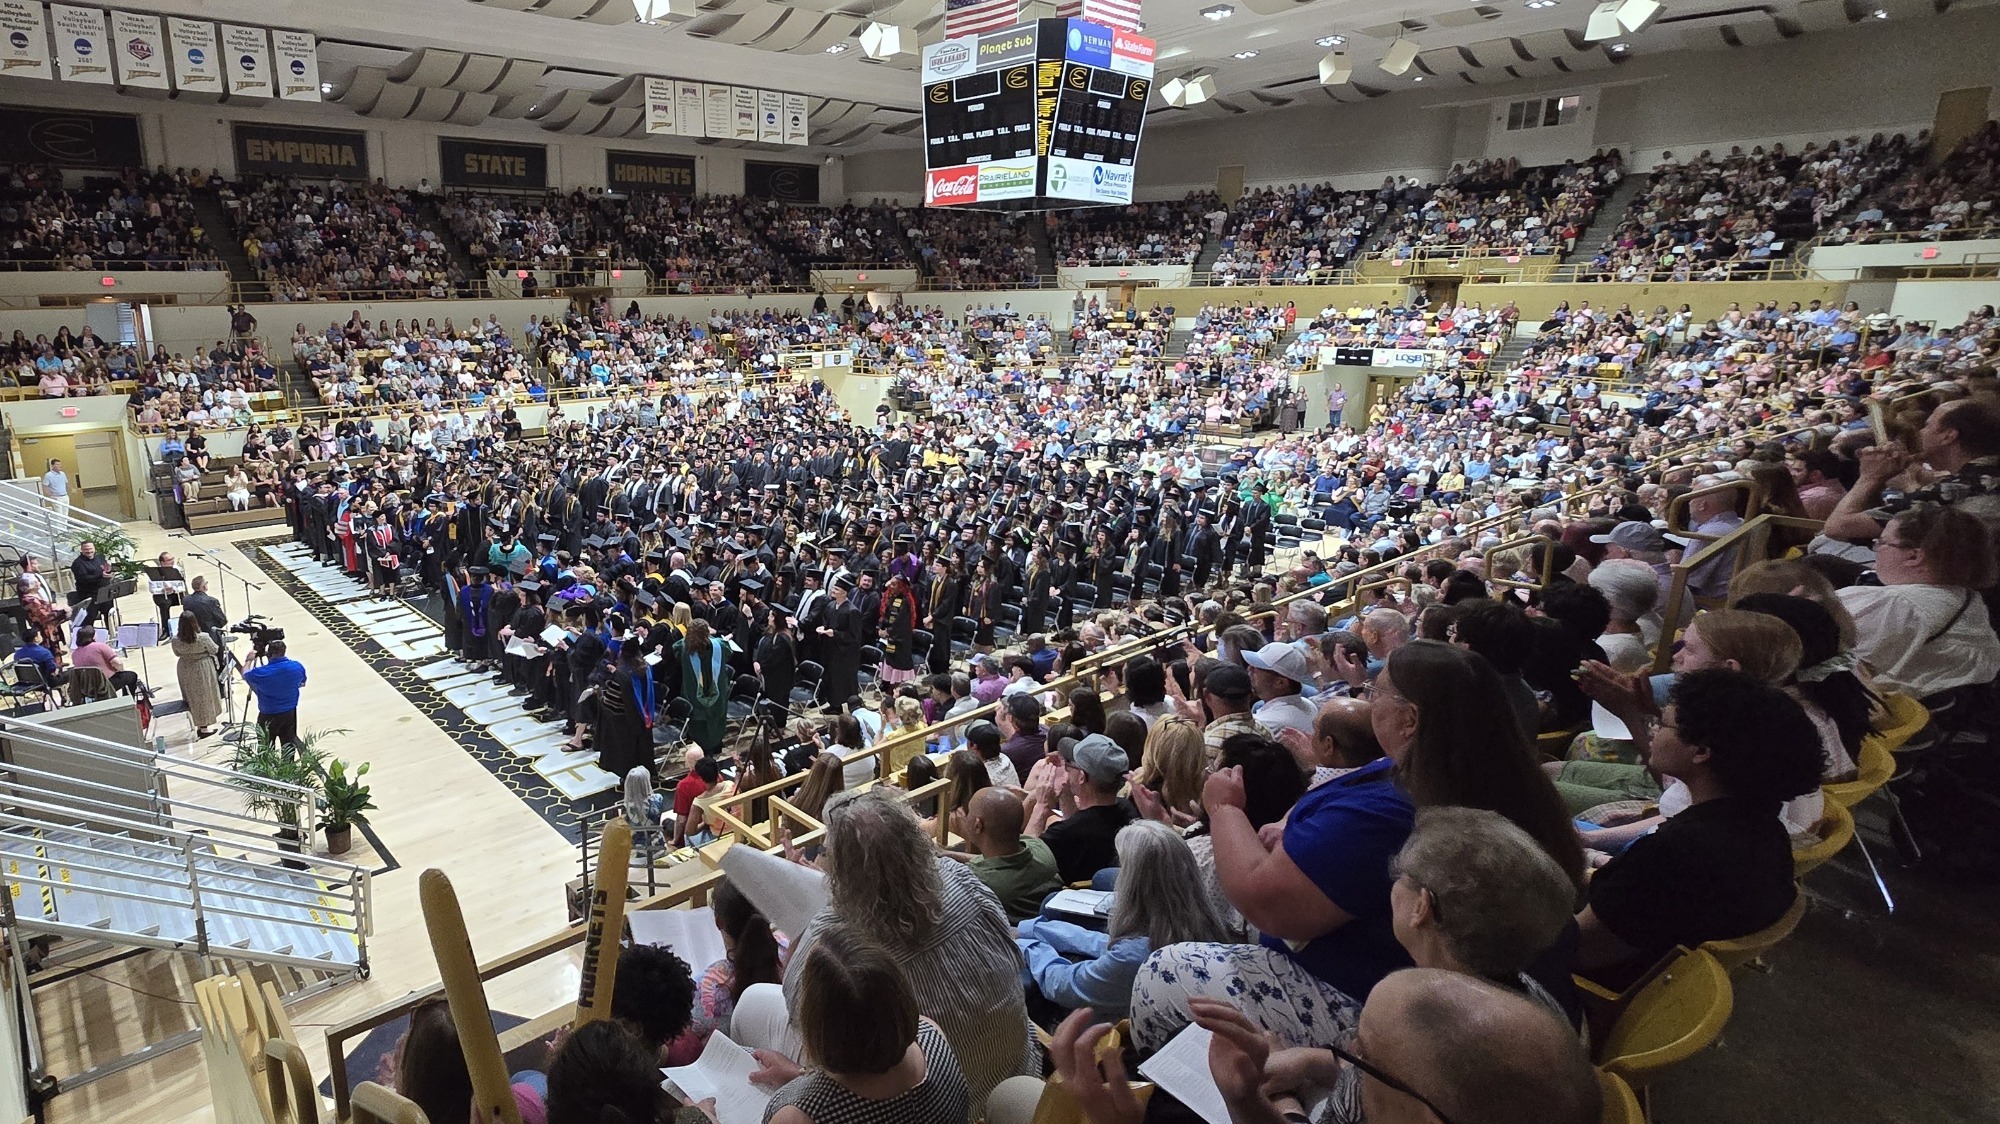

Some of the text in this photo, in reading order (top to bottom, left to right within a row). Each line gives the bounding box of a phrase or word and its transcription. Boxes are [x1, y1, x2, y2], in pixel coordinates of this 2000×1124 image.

[63, 15, 97, 24] Volleyball
[120, 21, 154, 29] Volleyball
[3, 23, 32, 31] Regional
[66, 28, 97, 36] Regional
[119, 27, 156, 35] Champions
[231, 34, 259, 42] Volleyball
[980, 35, 1033, 55] Planet Sub
[1083, 35, 1111, 48] NEWMAN
[932, 52, 966, 66] WILLIAMS
[1038, 61, 1062, 87] William
[1038, 97, 1057, 117] White
[1038, 118, 1053, 156] Auditorium
[247, 138, 357, 167] EMPORIA
[465, 153, 526, 177] STATE
[614, 163, 691, 186] HORNETS
[1104, 169, 1132, 183] Navrat's
[578, 889, 608, 1008] HORNETS
